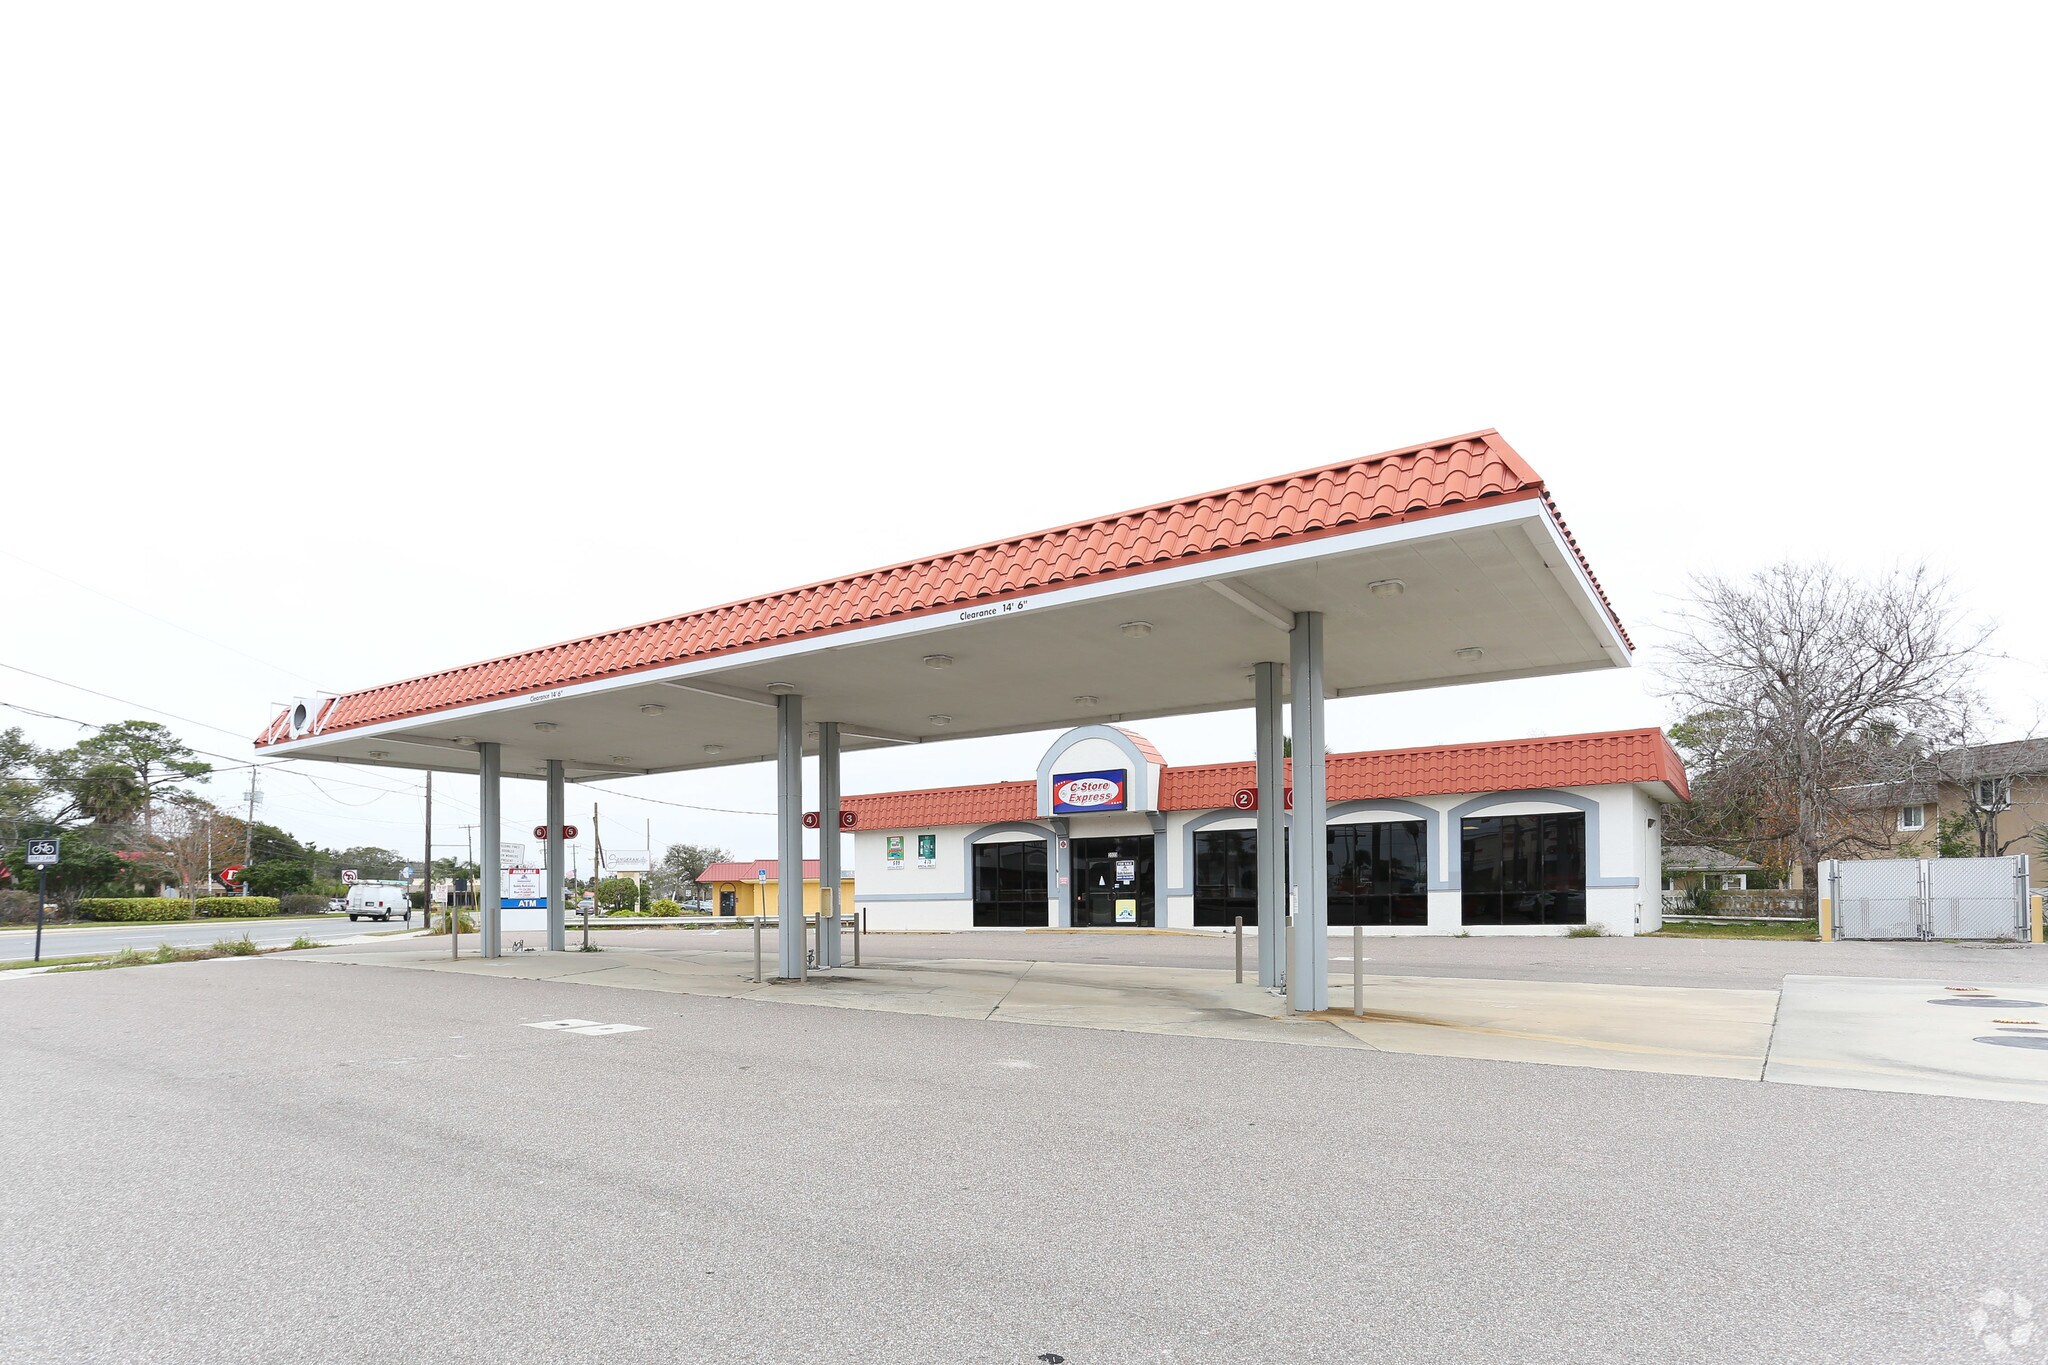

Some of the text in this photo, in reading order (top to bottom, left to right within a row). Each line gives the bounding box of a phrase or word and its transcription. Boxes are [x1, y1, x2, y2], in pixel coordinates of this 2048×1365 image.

[960, 608, 997, 620] Clearance
[1003, 603, 1014, 612] 14'
[530, 694, 550, 702] Clearance
[1070, 782, 1109, 792] C-Store
[1069, 793, 1111, 803] Express
[1240, 794, 1248, 804] 2
